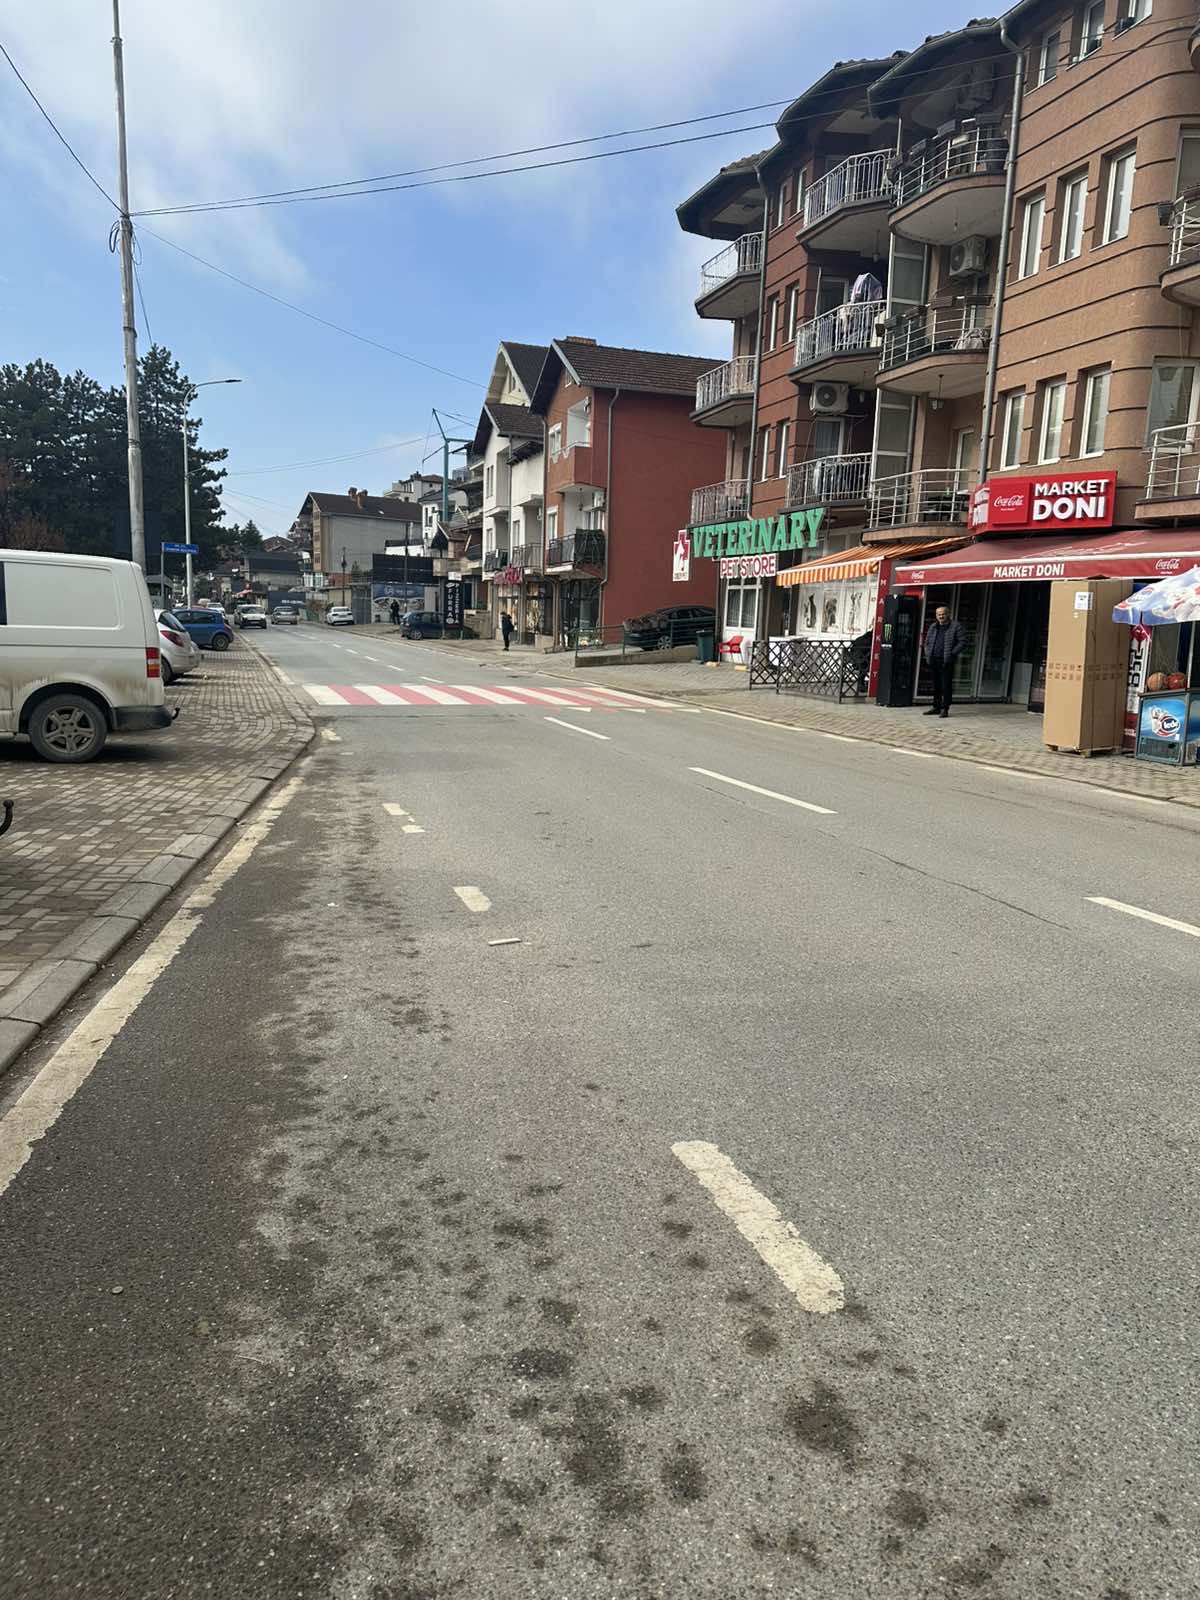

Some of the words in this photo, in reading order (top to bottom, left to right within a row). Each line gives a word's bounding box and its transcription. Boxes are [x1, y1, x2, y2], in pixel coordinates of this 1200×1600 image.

[1034, 479, 1110, 497] MARKET
[1032, 497, 1105, 521] DONI
[691, 507, 826, 558] VETERINARY
[720, 558, 740, 577] PET
[740, 554, 776, 577] STORE
[993, 564, 1034, 578] MARKET
[1036, 563, 1065, 577] DONI
